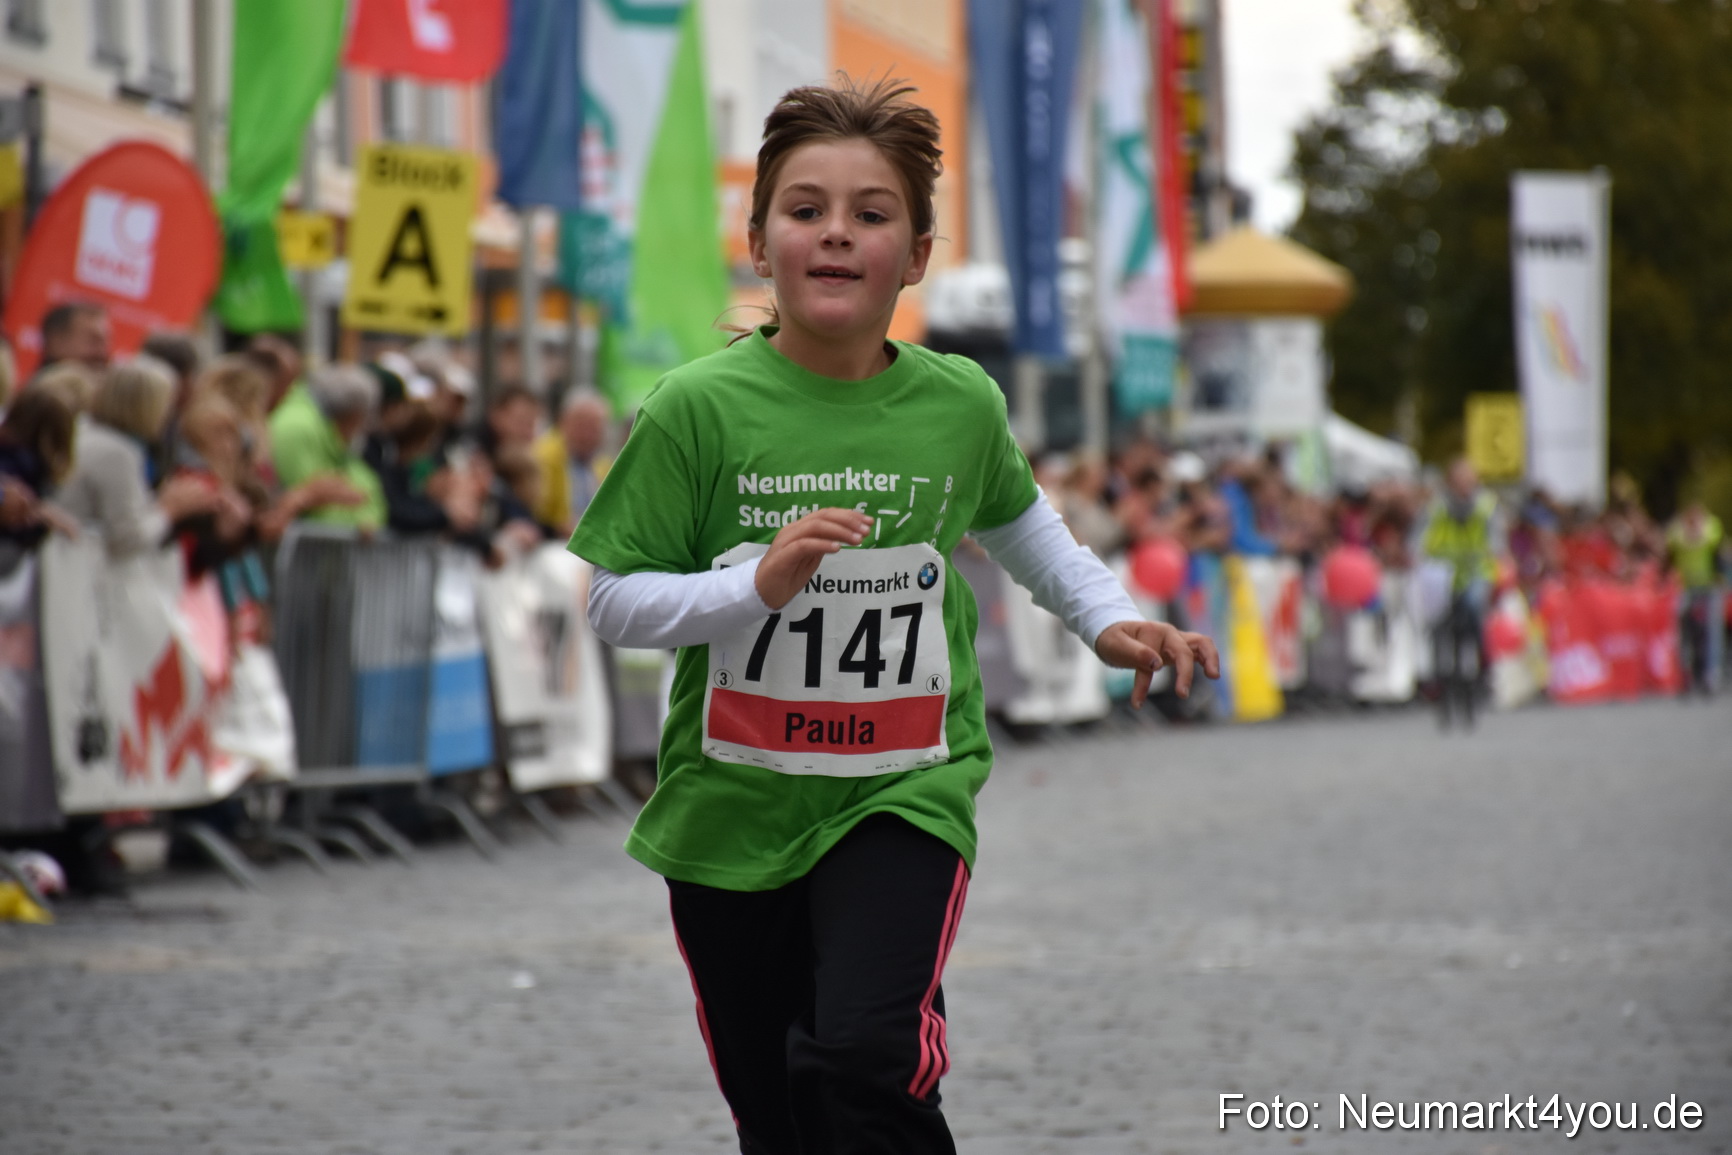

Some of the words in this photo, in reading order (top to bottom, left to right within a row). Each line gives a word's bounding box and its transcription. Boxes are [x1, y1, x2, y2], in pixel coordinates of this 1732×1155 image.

[375, 205, 441, 290] A
[737, 466, 900, 494] Neumarkter
[738, 502, 868, 528] Stadtf
[804, 572, 910, 595] Neumarkt
[744, 602, 924, 689] 7147
[719, 672, 728, 686] 3
[931, 676, 940, 691] K
[785, 712, 875, 745] Paula
